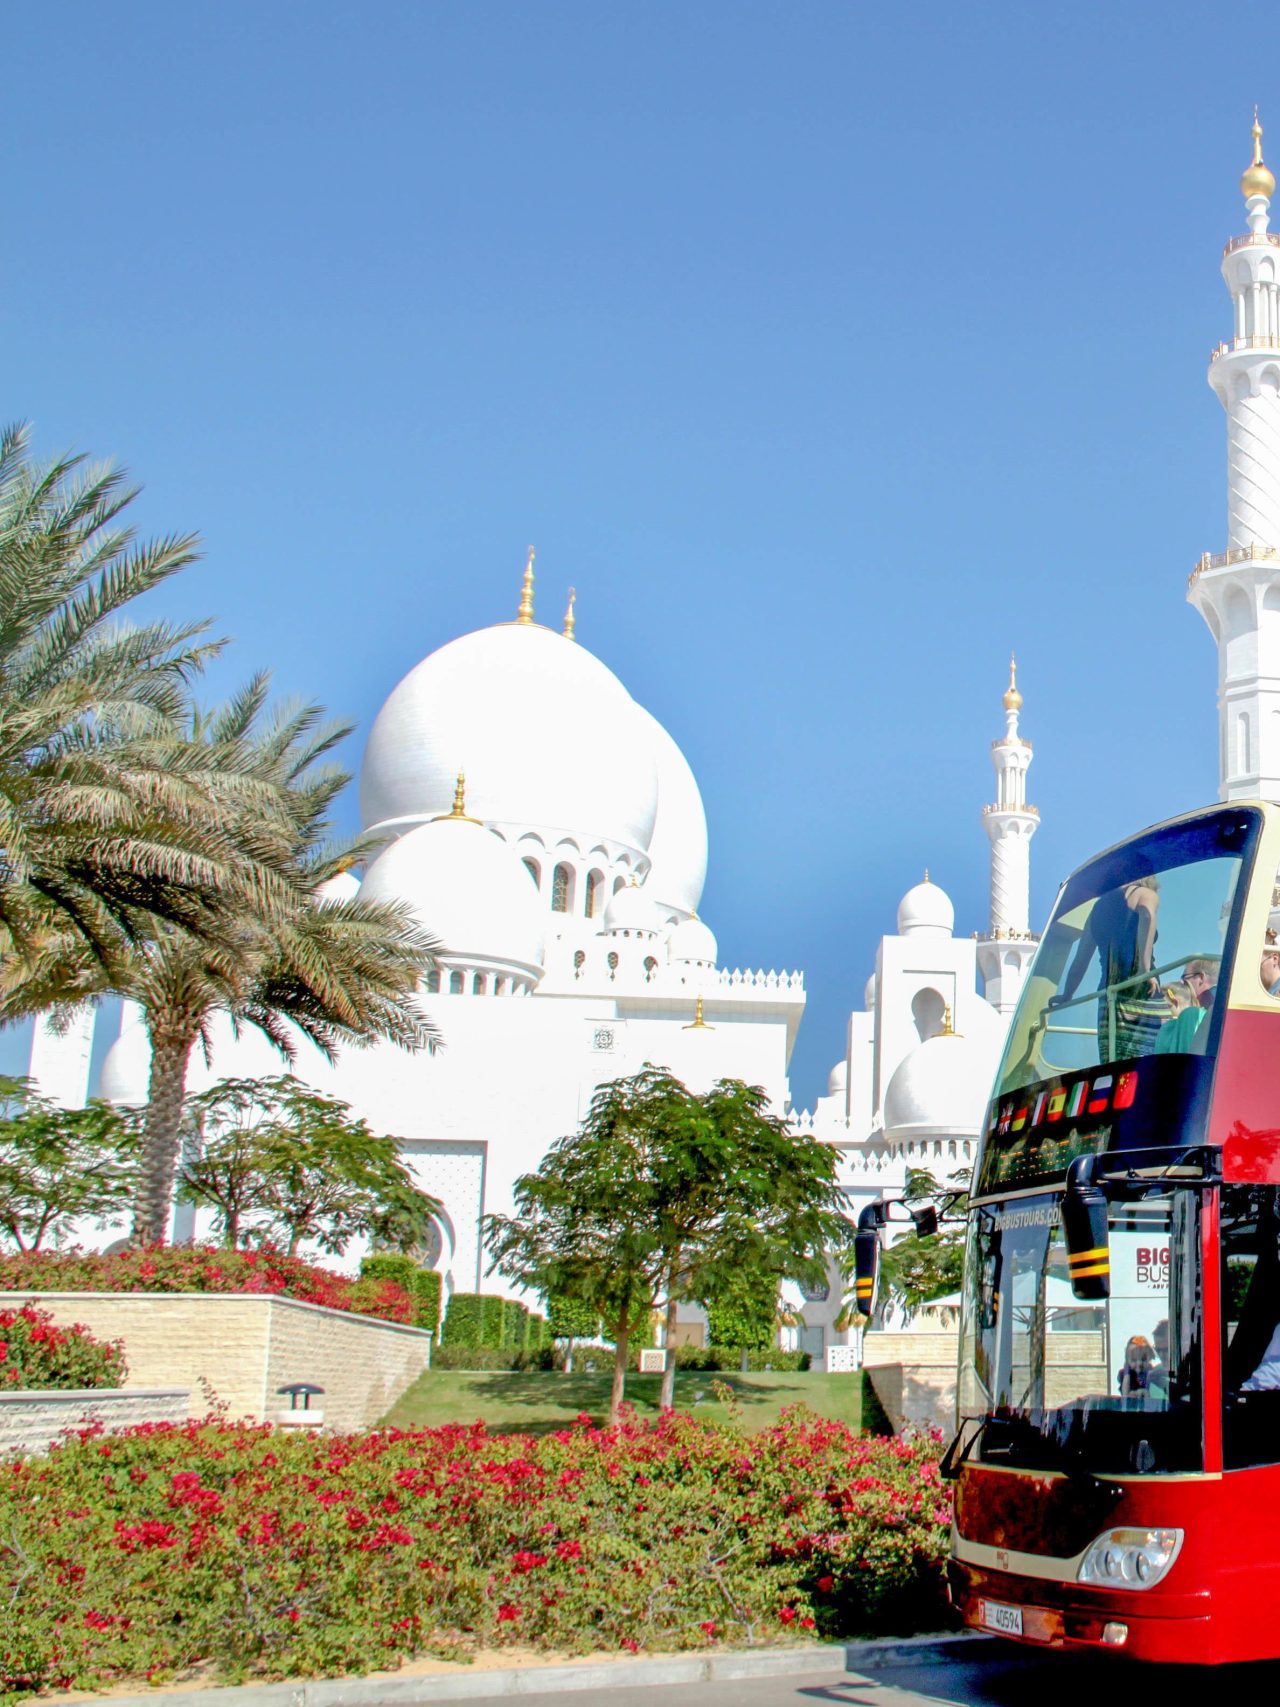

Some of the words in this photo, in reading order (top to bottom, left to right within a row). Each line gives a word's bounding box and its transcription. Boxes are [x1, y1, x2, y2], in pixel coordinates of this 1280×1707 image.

[1136, 1247, 1170, 1265] BIG
[1137, 1267, 1170, 1283] BUS
[996, 1608, 1019, 1631] 40594
